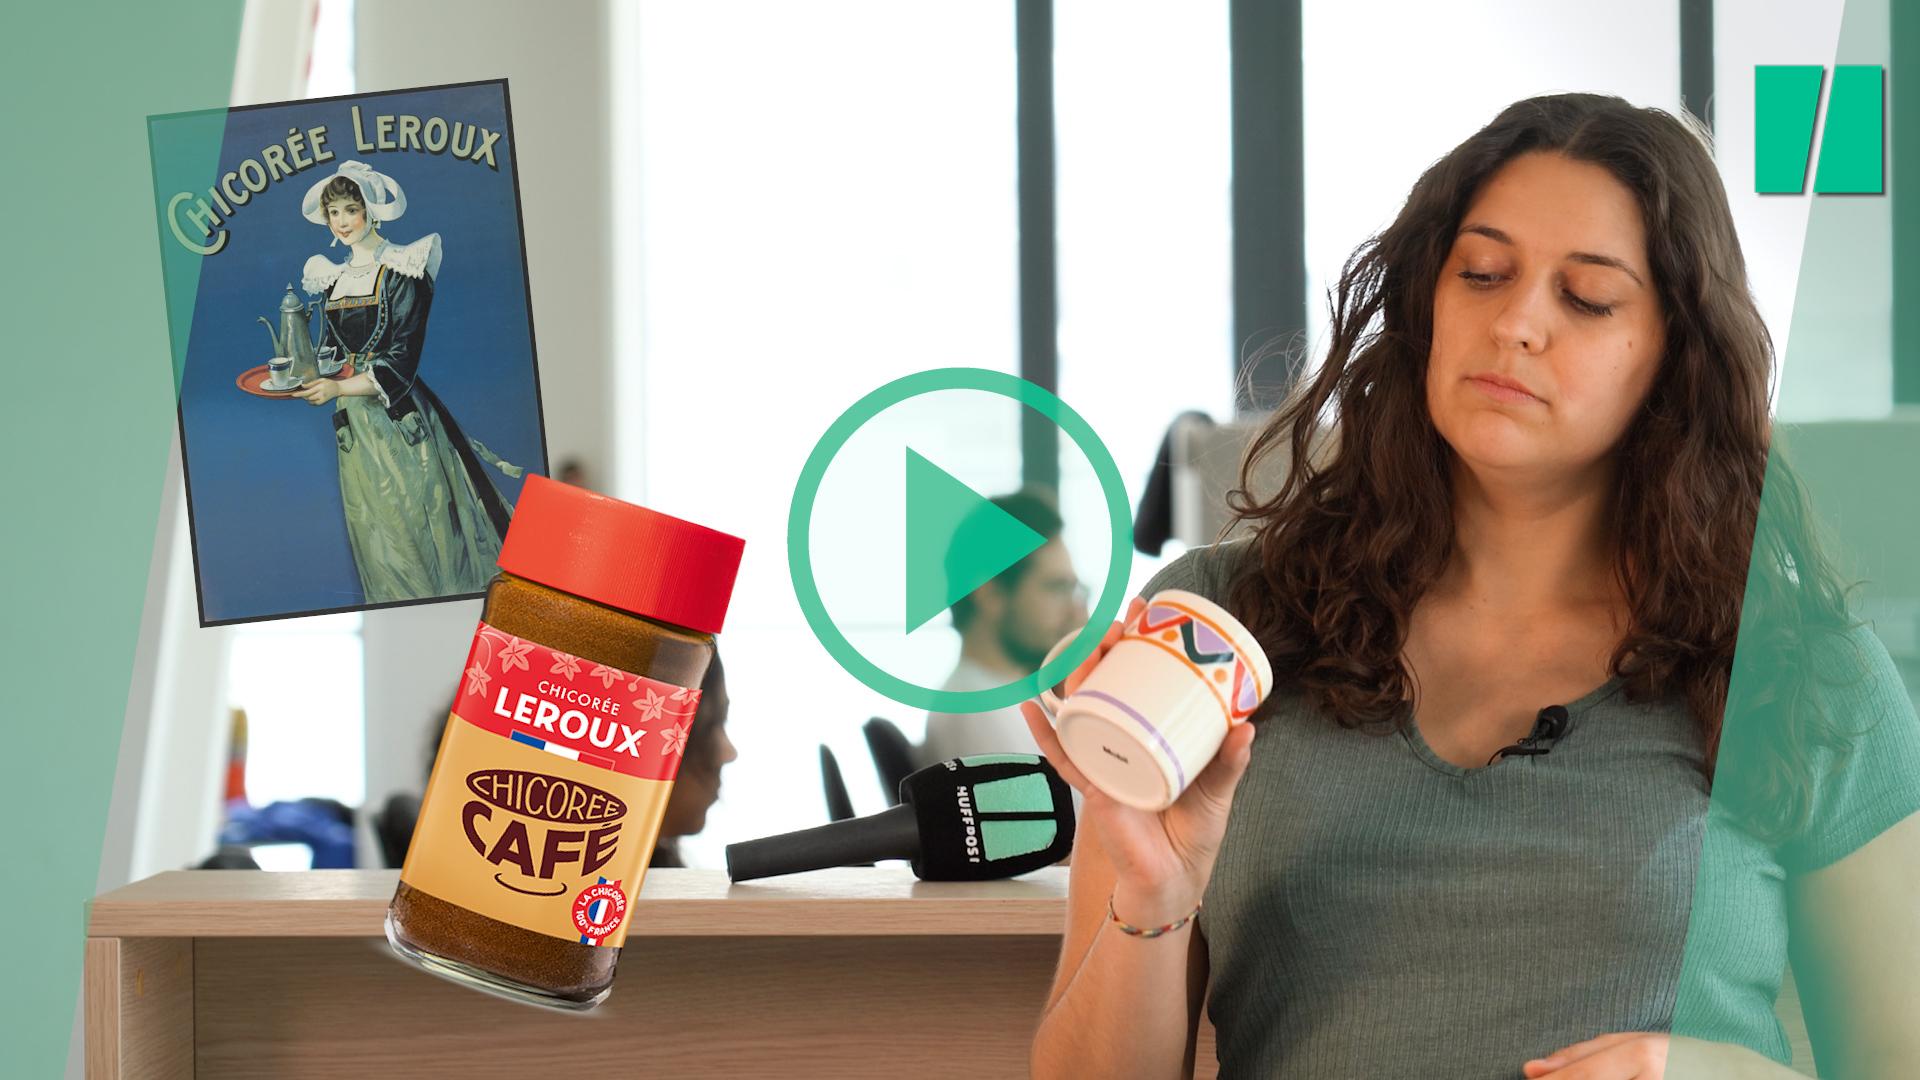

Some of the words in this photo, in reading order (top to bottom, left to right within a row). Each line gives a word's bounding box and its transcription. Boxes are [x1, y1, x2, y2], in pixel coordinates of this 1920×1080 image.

[167, 126, 335, 256] CHICORÉE
[351, 105, 502, 172] LEROUX
[537, 680, 621, 716] CHICORÉE
[493, 686, 648, 758] LEROUX
[472, 774, 620, 821] CHICORÉE
[462, 800, 623, 880] CAFÉ
[578, 894, 592, 906] LA
[591, 887, 625, 912] CHICORÉE
[587, 917, 621, 936] FRANCE
